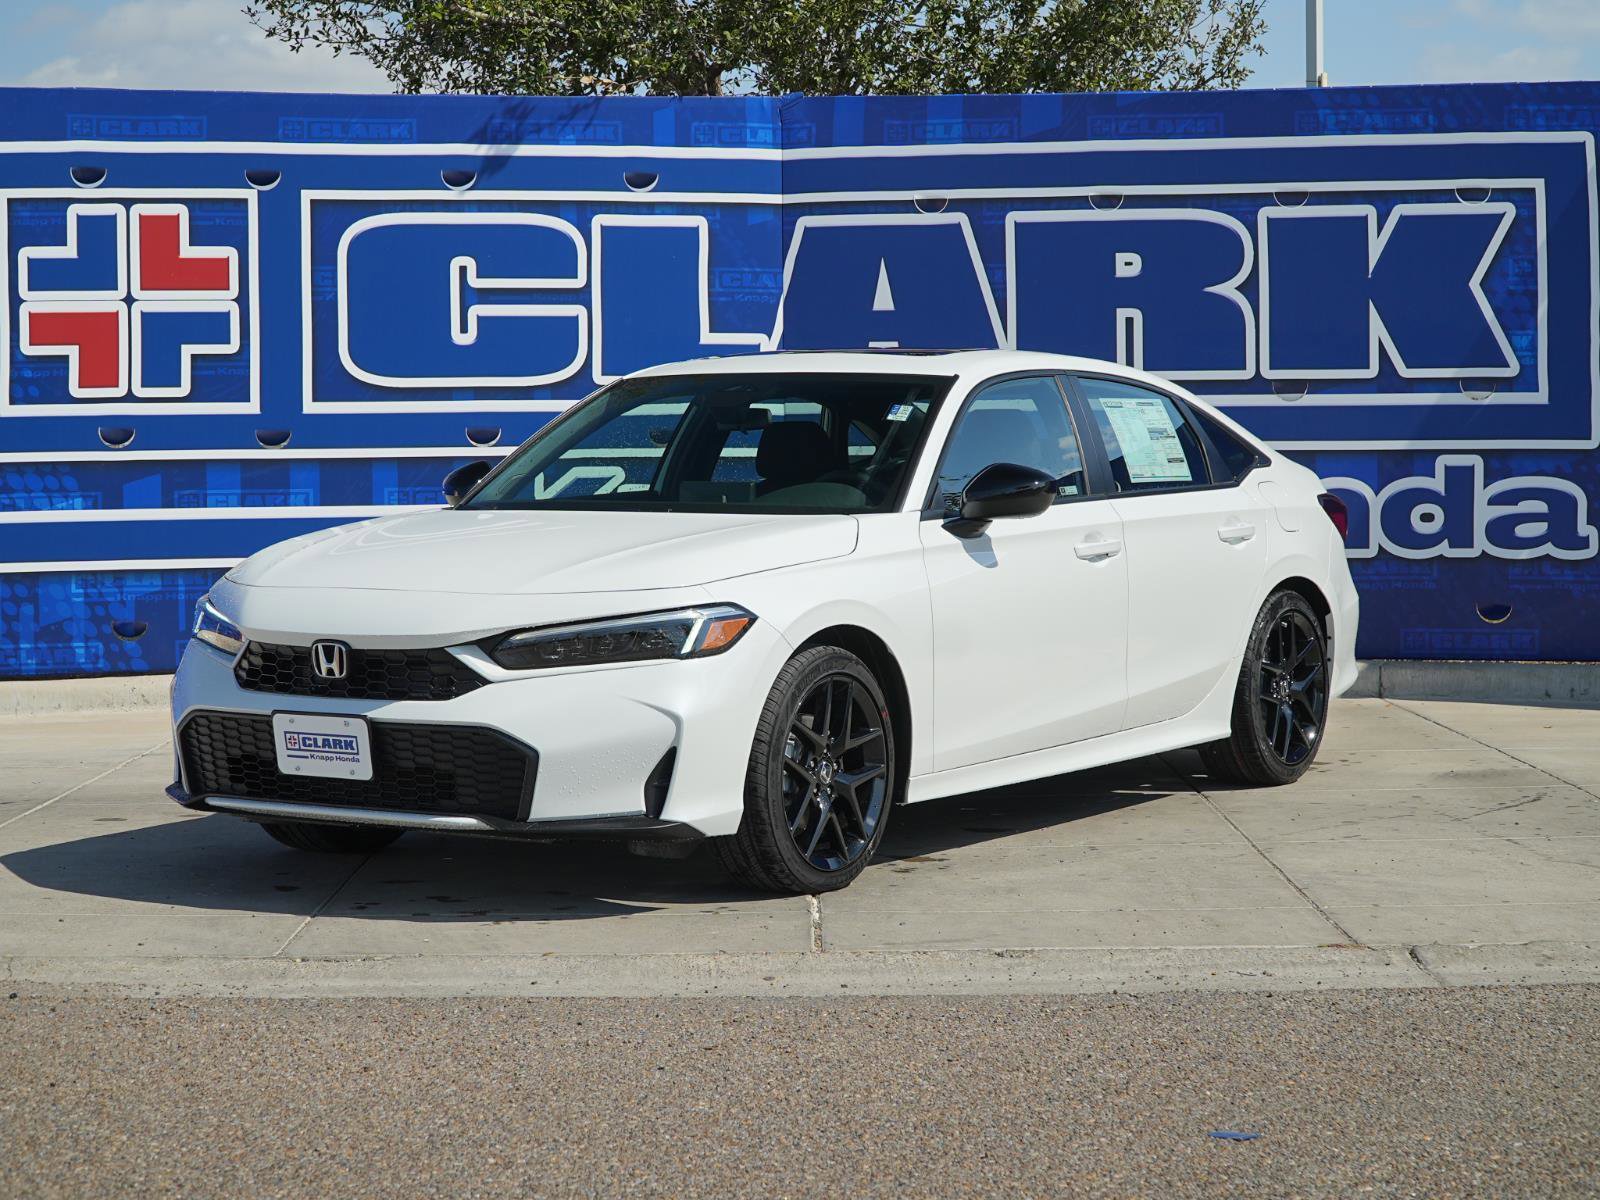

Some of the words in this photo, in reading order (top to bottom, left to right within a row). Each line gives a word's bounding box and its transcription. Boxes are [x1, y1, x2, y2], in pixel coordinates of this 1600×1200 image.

[337, 203, 1519, 388] CLARK
[302, 736, 356, 751] CLARK
[309, 754, 335, 763] Knapp
[335, 754, 360, 763] Honda
